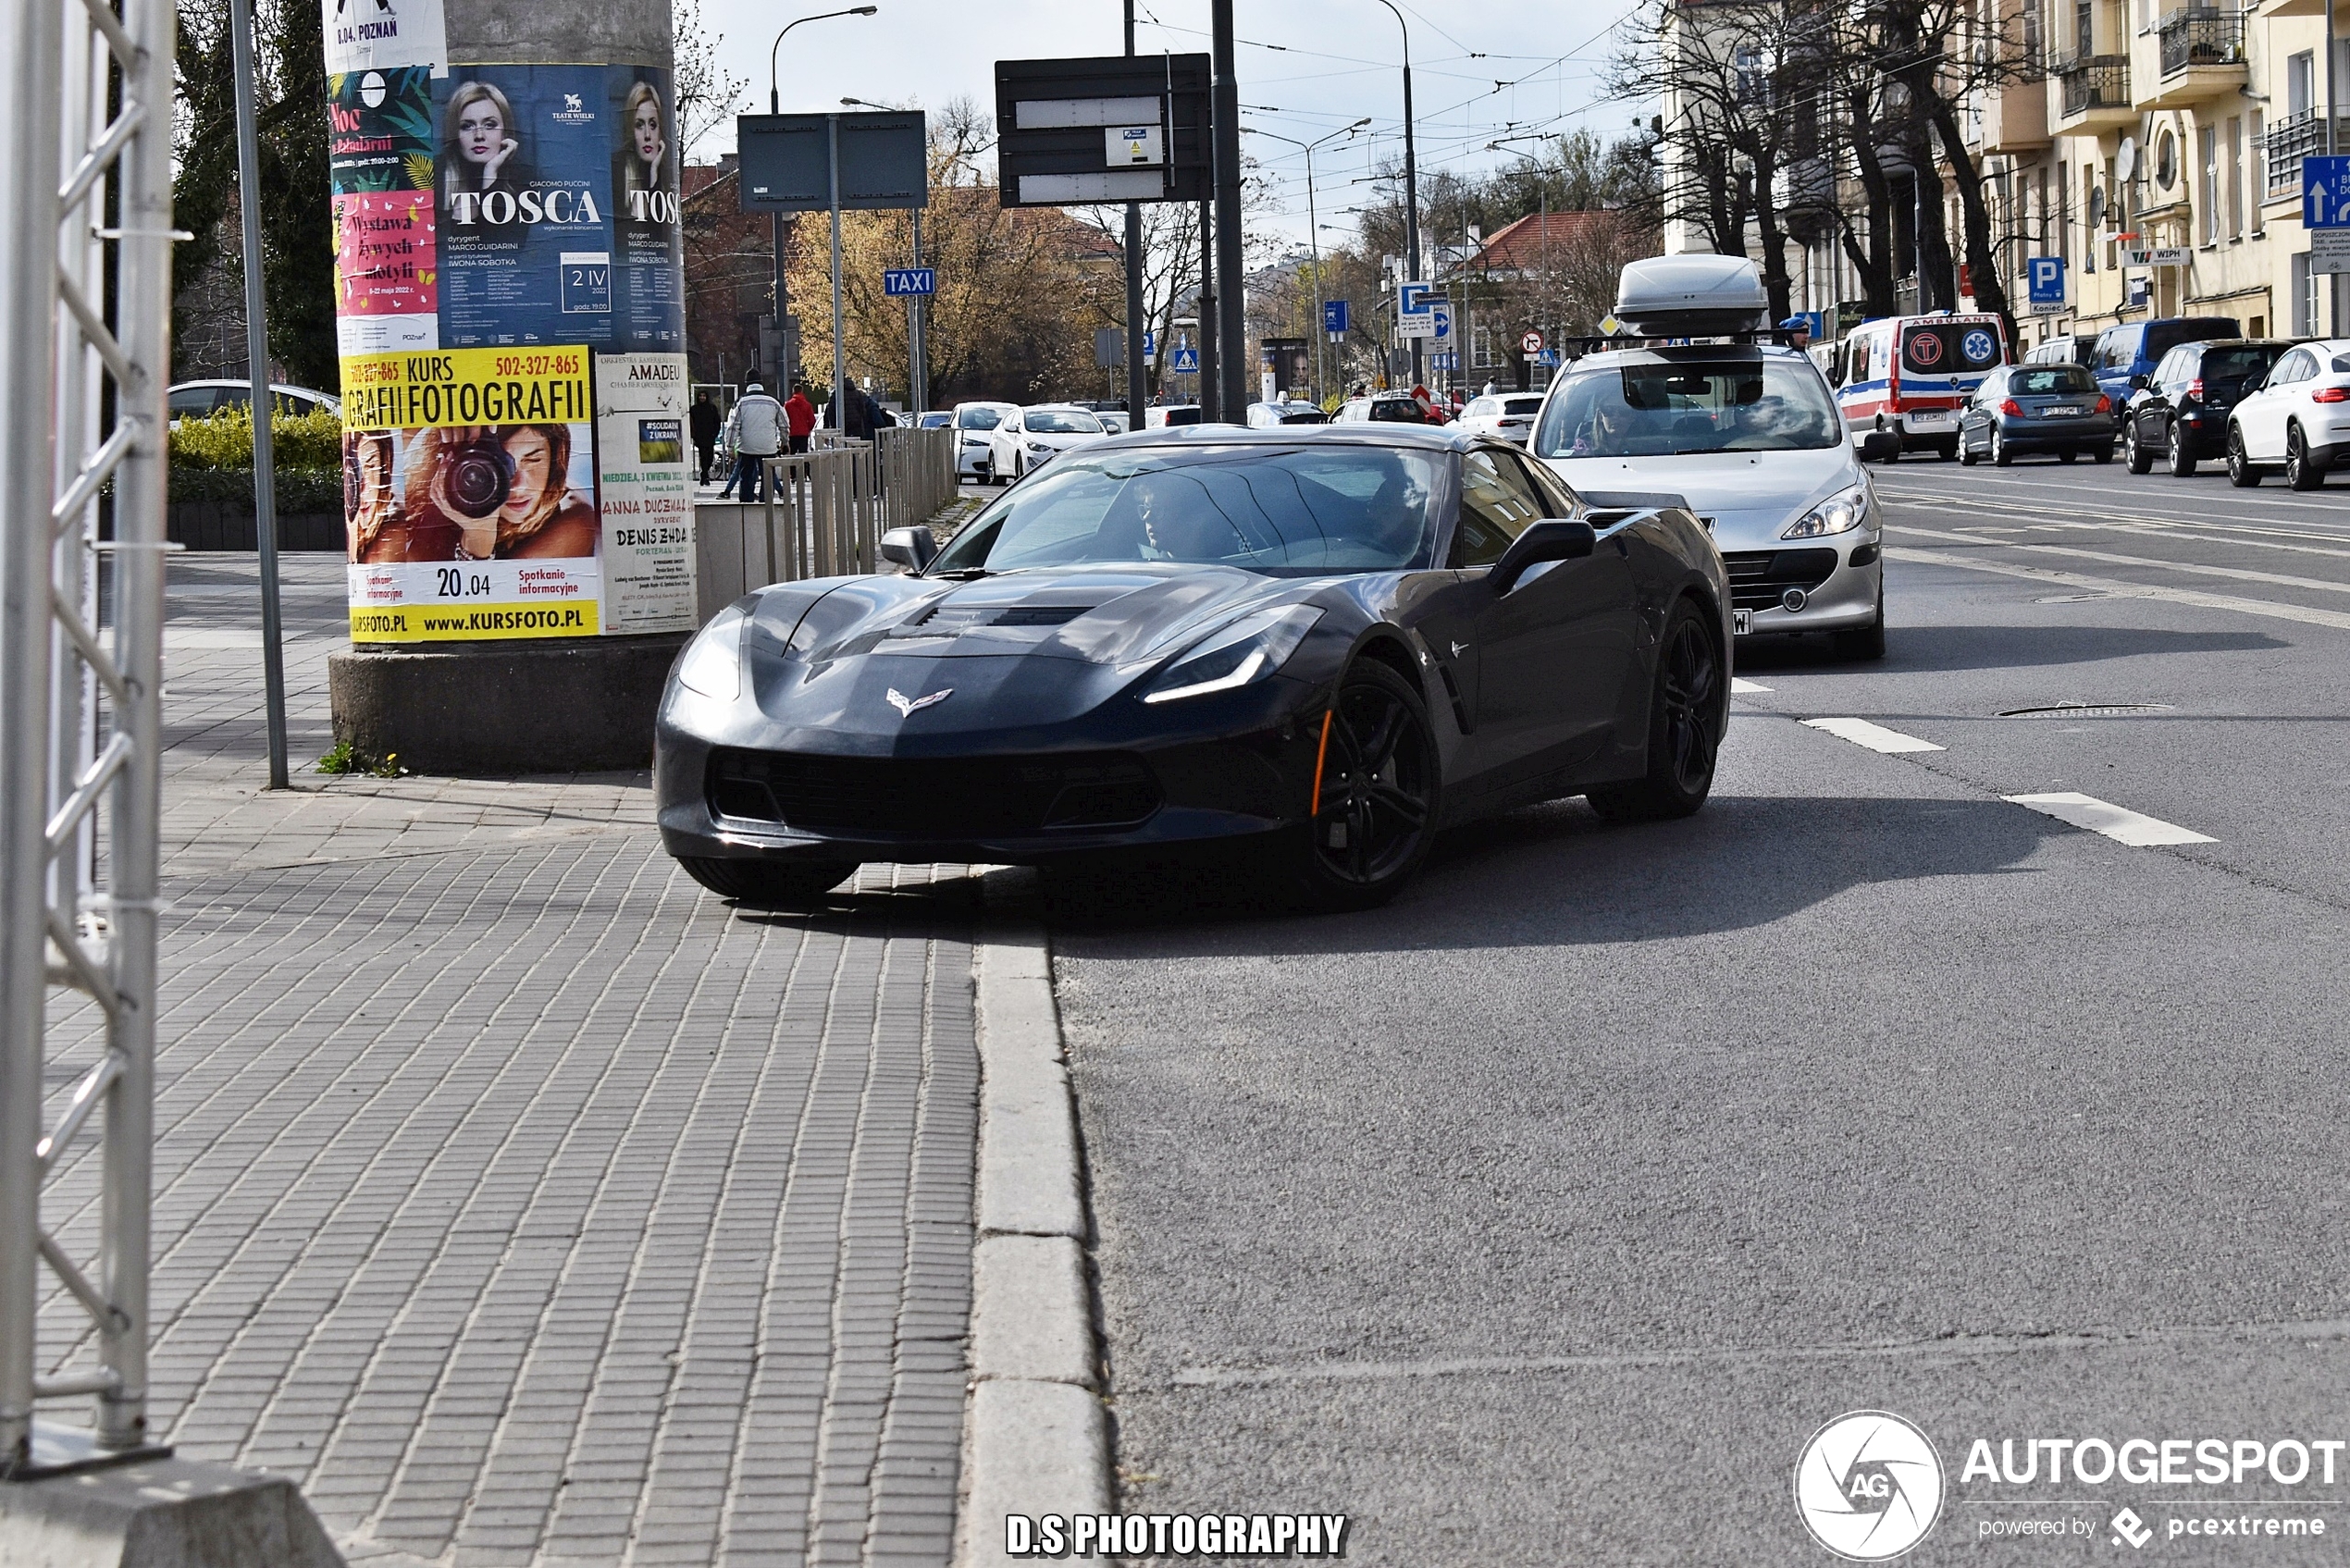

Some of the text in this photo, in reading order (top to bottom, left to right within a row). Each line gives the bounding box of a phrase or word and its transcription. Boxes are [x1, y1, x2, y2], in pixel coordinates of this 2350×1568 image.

[337, 18, 397, 44] 8.04. POZNAŃ
[330, 103, 360, 133] Noc
[563, 179, 591, 188] PUCCINI
[451, 190, 601, 225] TOSCA
[352, 216, 413, 236] Wystawa
[359, 239, 413, 259] żywych
[448, 235, 480, 243] dyrygent
[2157, 250, 2181, 258] WIPH
[365, 262, 413, 283] motyli
[572, 270, 606, 286] 2 IV
[886, 272, 930, 292] TAXI
[2036, 261, 2057, 290] P
[381, 287, 394, 295] maja
[395, 286, 410, 294] 2022
[1912, 316, 1990, 326] AMBULANS
[407, 356, 453, 382] KURS
[496, 355, 579, 377] 502-327-865
[408, 380, 584, 424] FOTOGRAFII
[641, 473, 646, 481] 3
[602, 500, 640, 515] ANNA
[616, 528, 657, 547] DENIS
[636, 547, 673, 556] FORTEPIAN
[437, 568, 490, 597] 20.04
[519, 569, 565, 583] Spotkanie
[519, 583, 579, 597] informacyjne
[424, 610, 584, 631] www.KURSFOTO.PL
